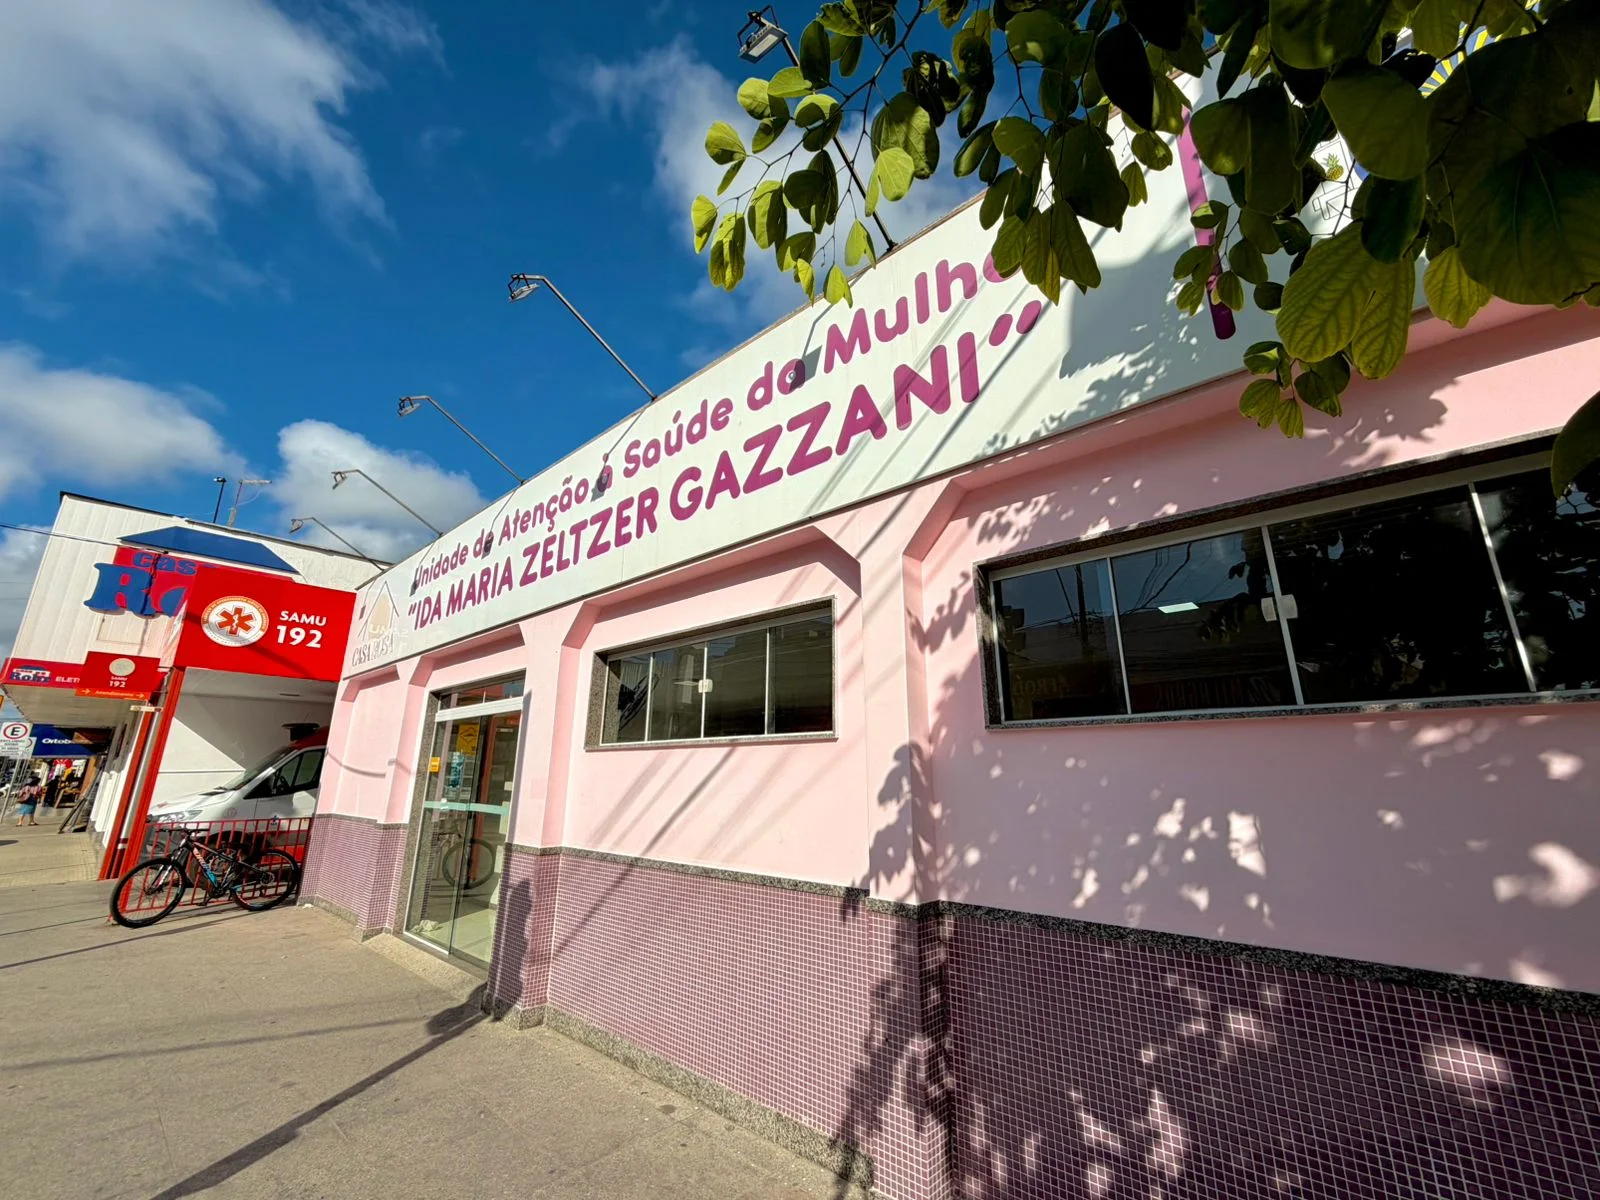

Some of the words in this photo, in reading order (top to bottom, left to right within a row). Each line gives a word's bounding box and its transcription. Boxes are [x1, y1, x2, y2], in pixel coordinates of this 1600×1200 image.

[413, 542, 469, 589] Unidade
[473, 528, 494, 558] de
[498, 474, 590, 546] Atenção
[623, 398, 734, 478] Saúde
[747, 358, 806, 411] da
[823, 251, 1021, 374] Mulh
[446, 556, 513, 617] MARIA
[519, 486, 660, 588] ZELTZER
[279, 610, 327, 627] SAMU
[276, 625, 322, 648] 192
[109, 680, 126, 688] 192
[10, 726, 21, 736] E
